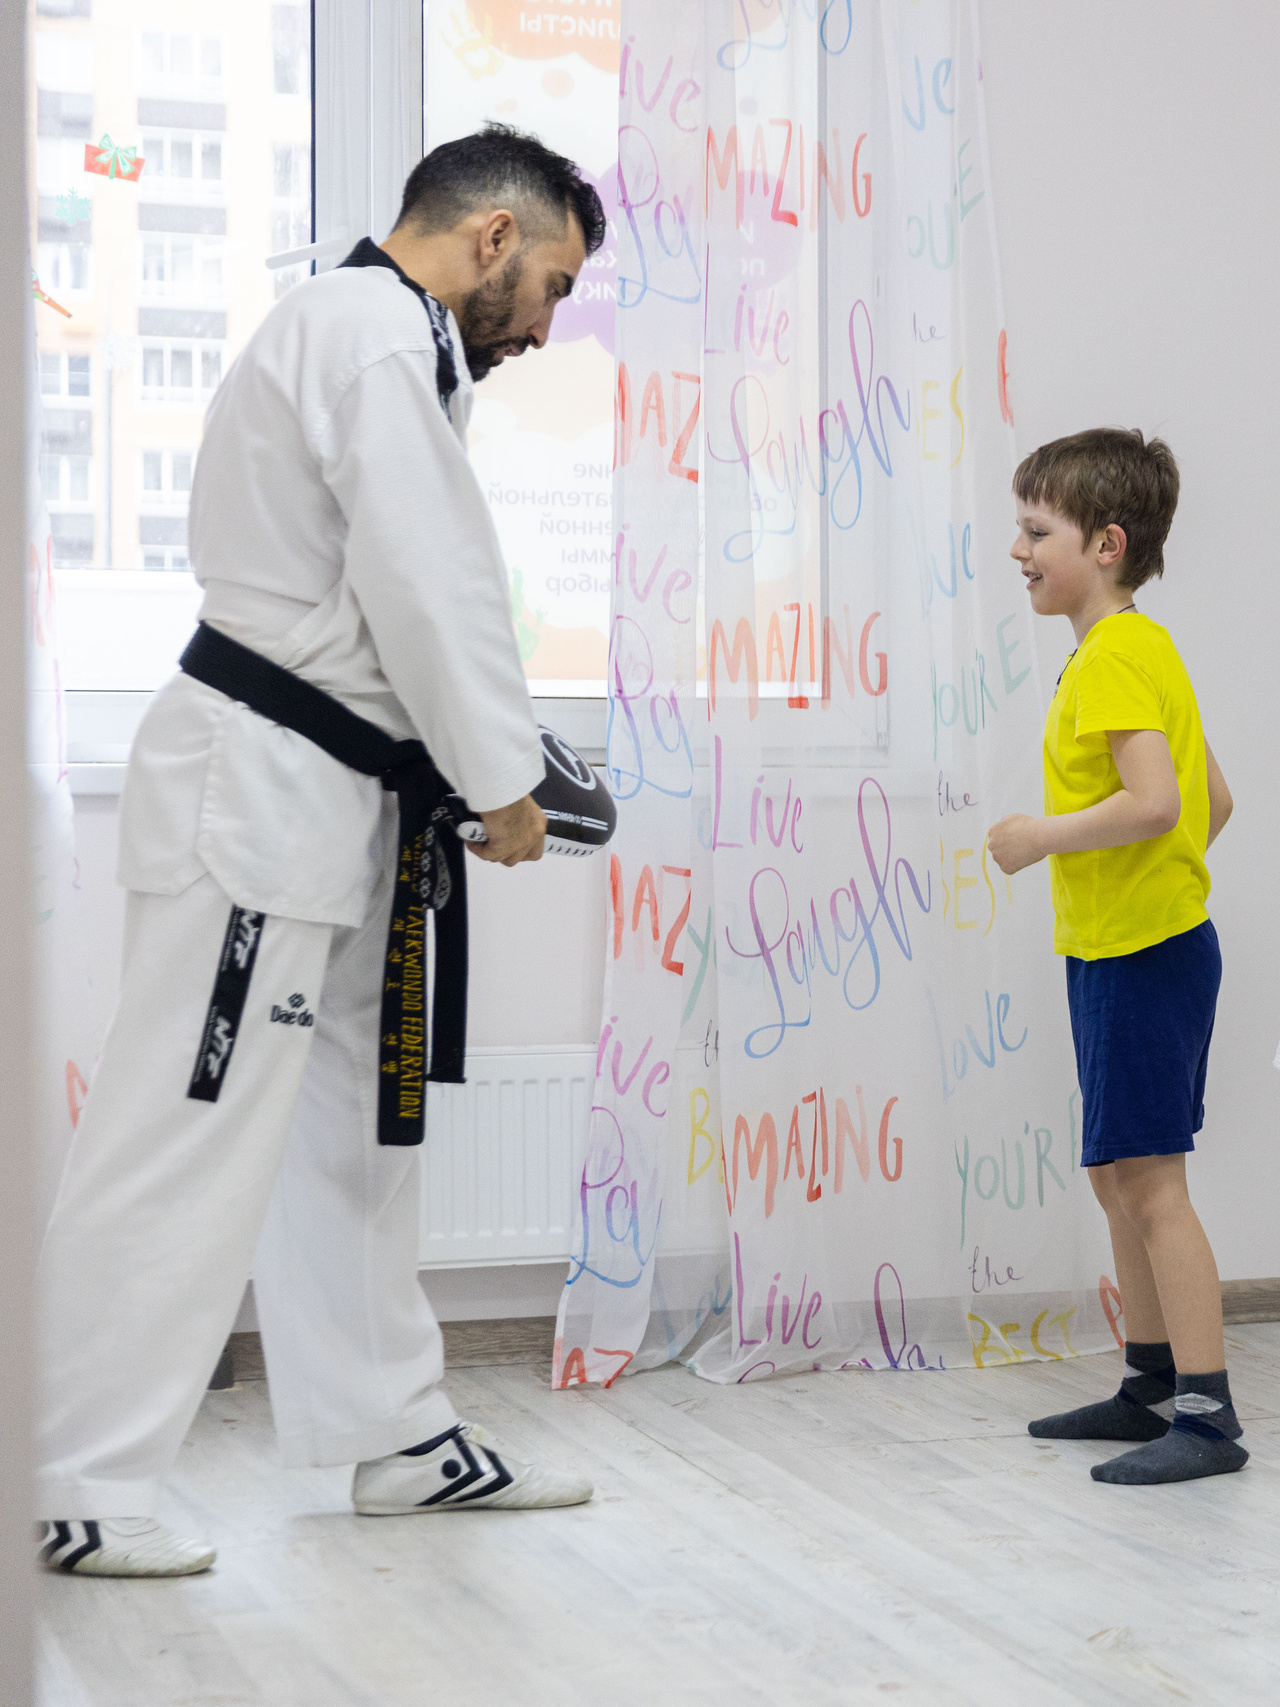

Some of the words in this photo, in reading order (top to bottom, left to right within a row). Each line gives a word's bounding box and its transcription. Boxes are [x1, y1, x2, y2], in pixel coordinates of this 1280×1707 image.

[712, 735, 804, 854] Live
[401, 905, 424, 1010] TAEKWONDO
[398, 1016, 425, 1118] FEDERATION
[734, 1231, 822, 1350] Live
[968, 1245, 1025, 1293] the
